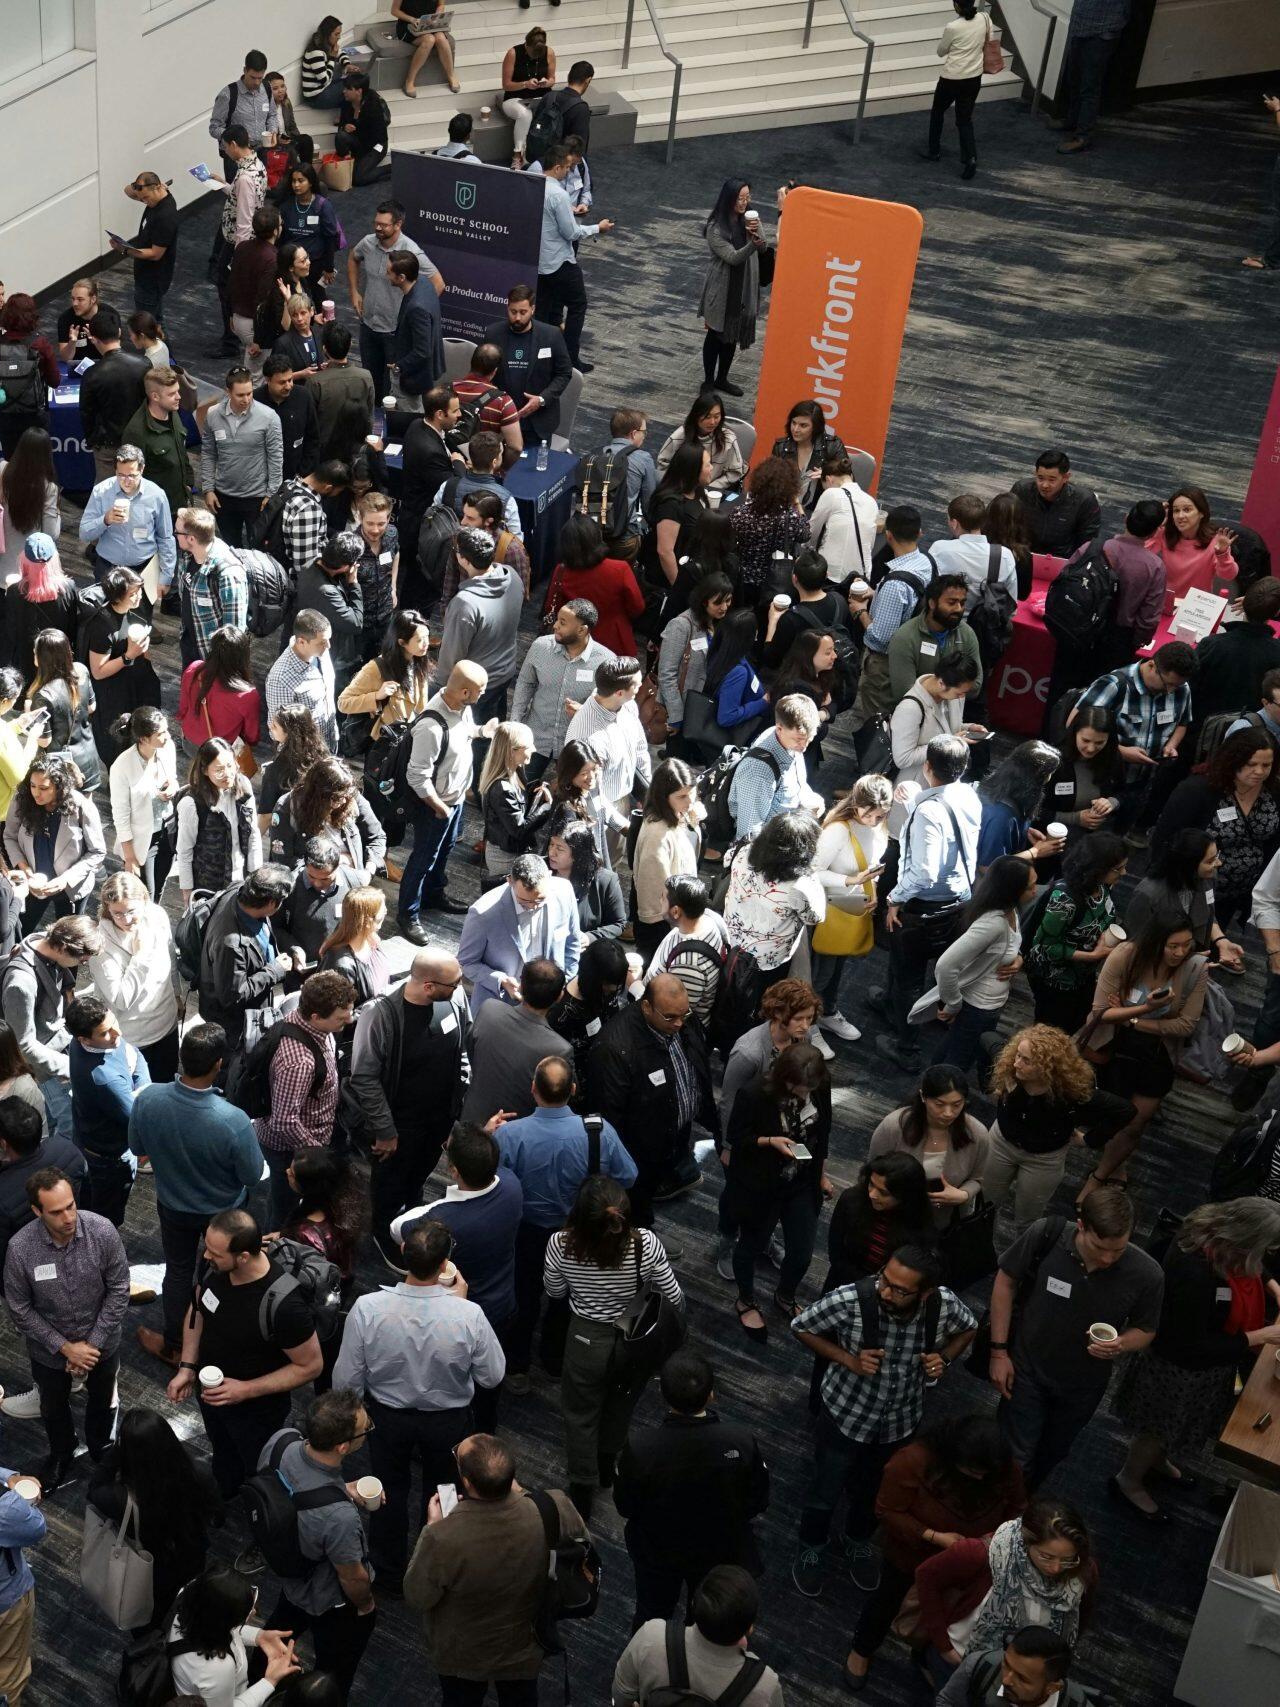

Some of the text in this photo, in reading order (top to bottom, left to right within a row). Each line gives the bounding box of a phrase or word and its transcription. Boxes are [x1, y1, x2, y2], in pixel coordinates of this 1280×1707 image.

[419, 209, 510, 235] PRODUCT SCHOOL
[434, 225, 492, 242] SILICON VALLEY
[451, 285, 483, 300] Product
[484, 291, 509, 305] Mana
[806, 256, 861, 436] orkfront
